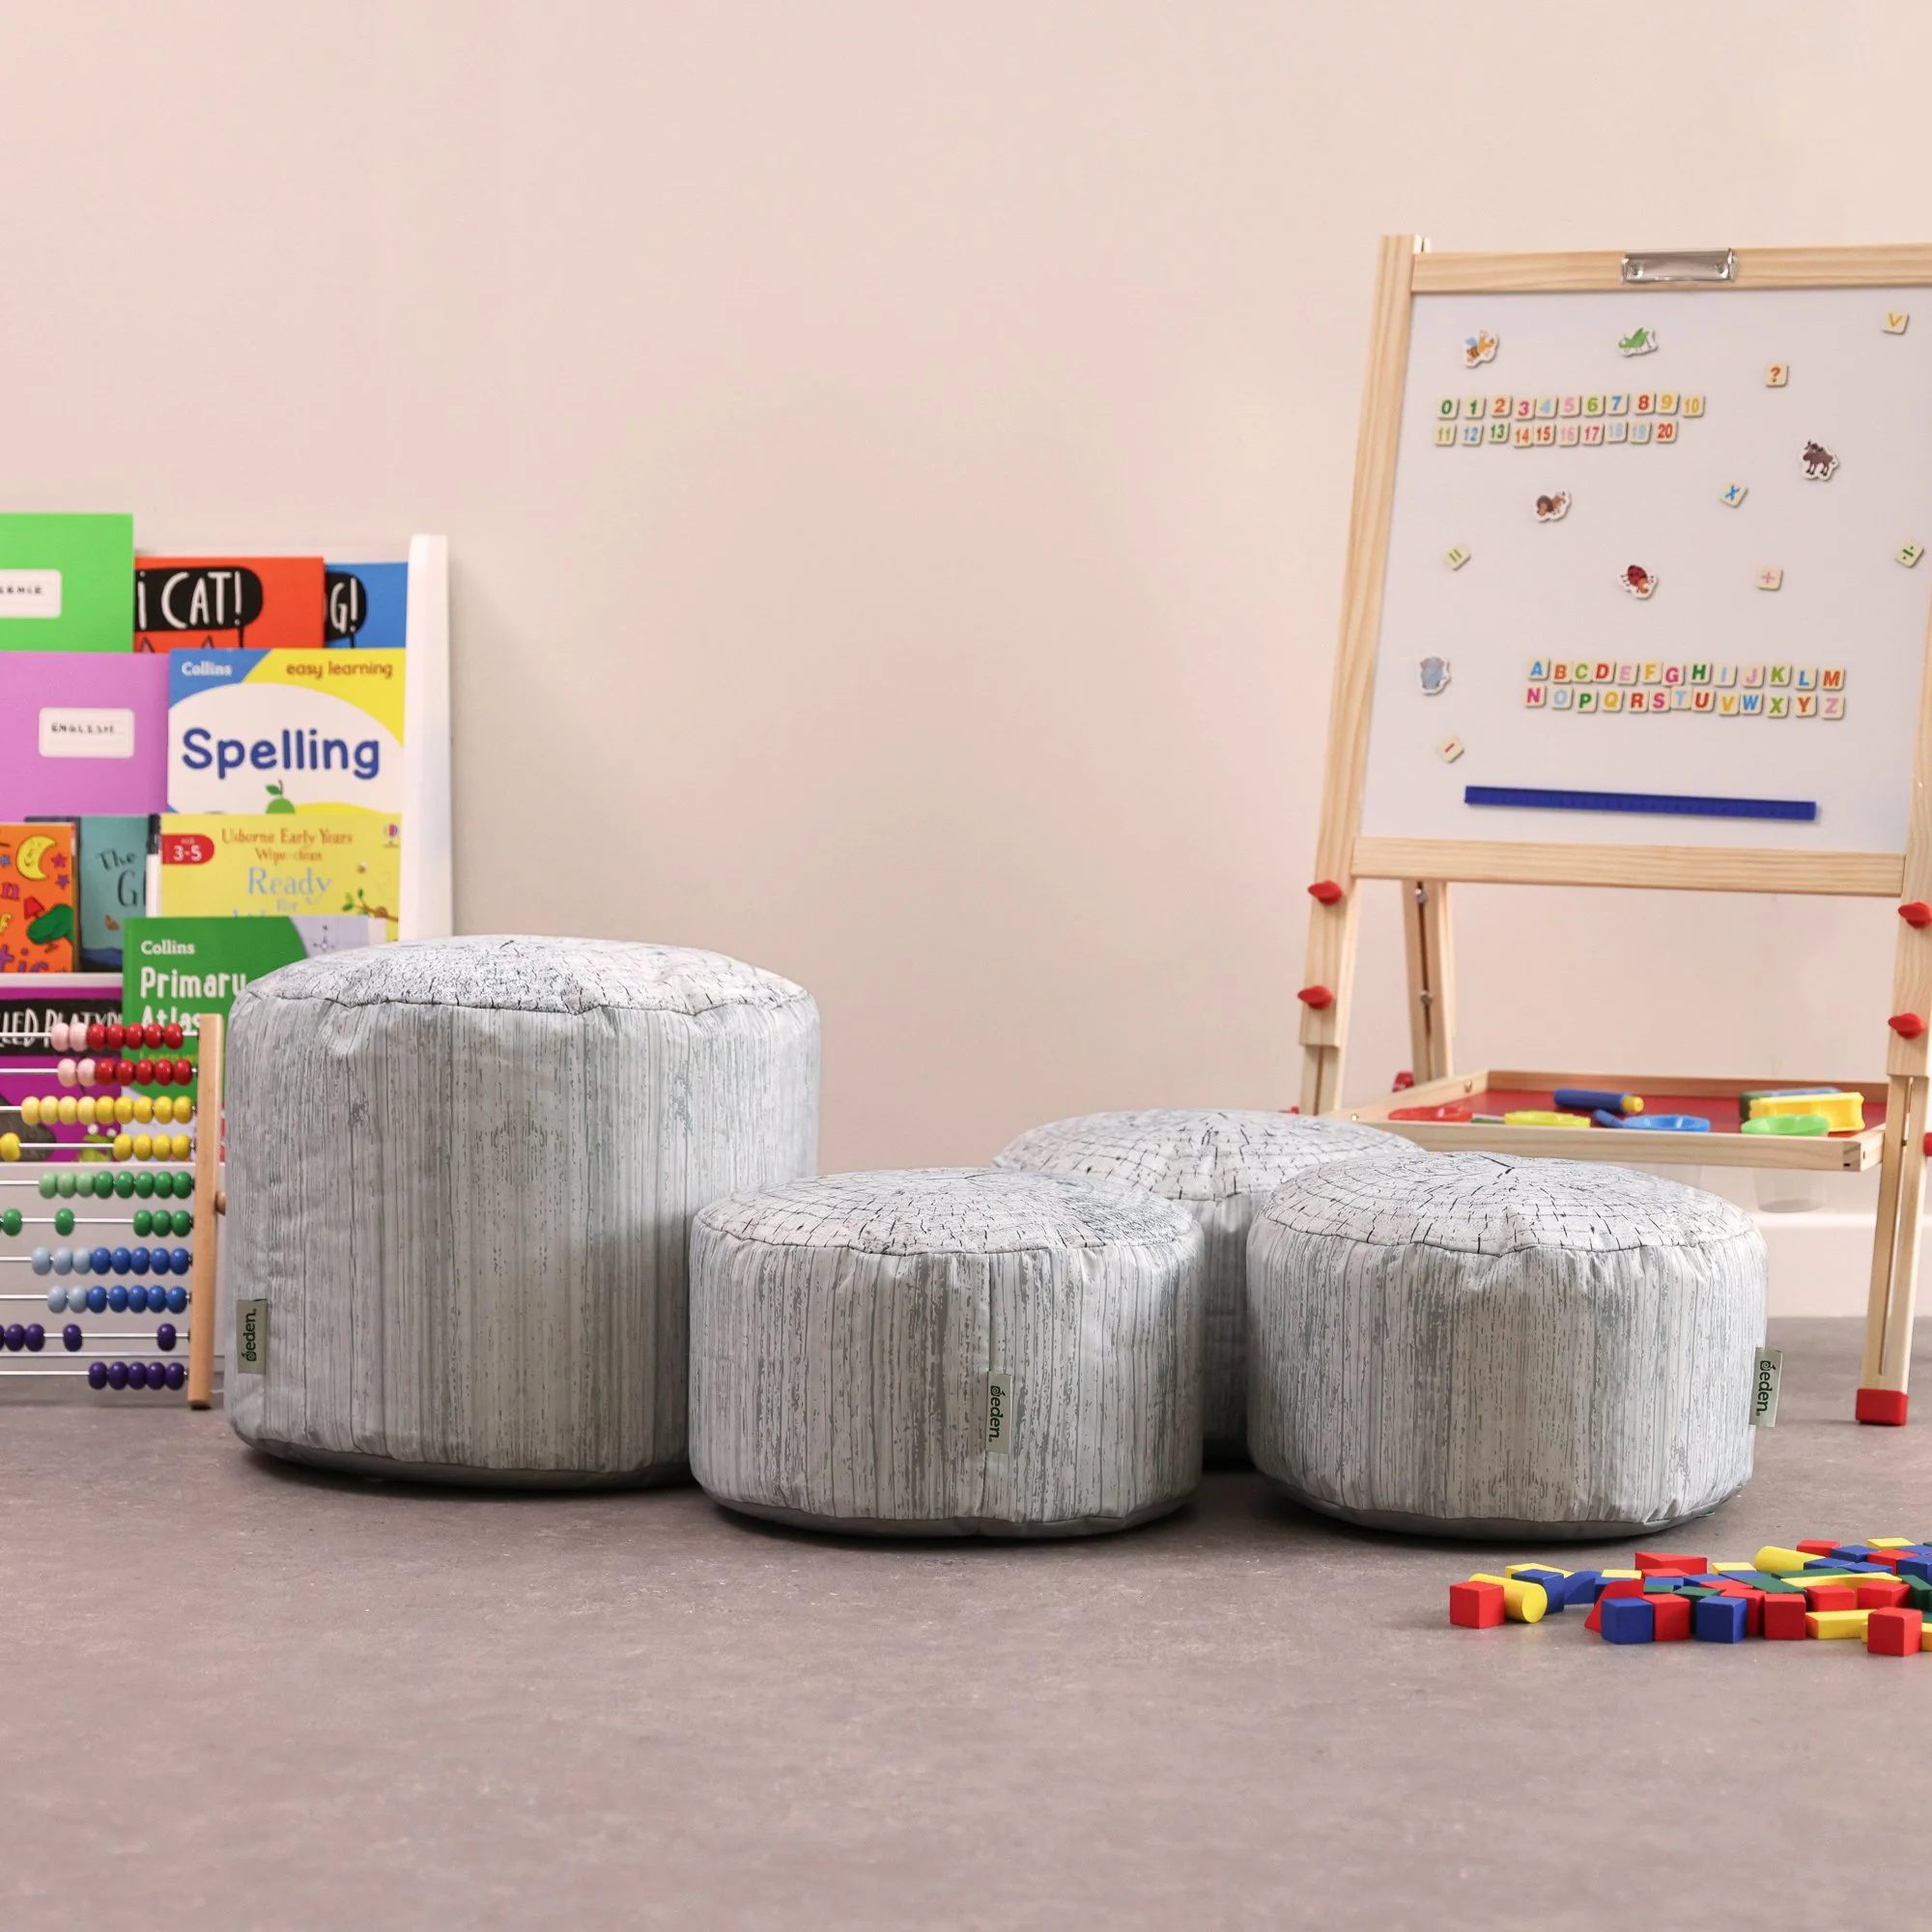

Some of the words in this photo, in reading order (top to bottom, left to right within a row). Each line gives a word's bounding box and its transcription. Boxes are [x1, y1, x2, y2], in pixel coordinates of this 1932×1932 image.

[160, 570, 242, 629] CAT!
[326, 578, 358, 633] G!
[182, 661, 233, 676] Collins
[286, 663, 323, 680] easy
[328, 661, 393, 679] learning
[182, 727, 380, 780] Spelling
[173, 844, 202, 862] 3-5
[118, 869, 146, 907] G
[248, 867, 333, 905] Ready
[140, 939, 197, 954] Collins
[140, 966, 247, 1000] Primary
[0, 1008, 40, 1048] LED
